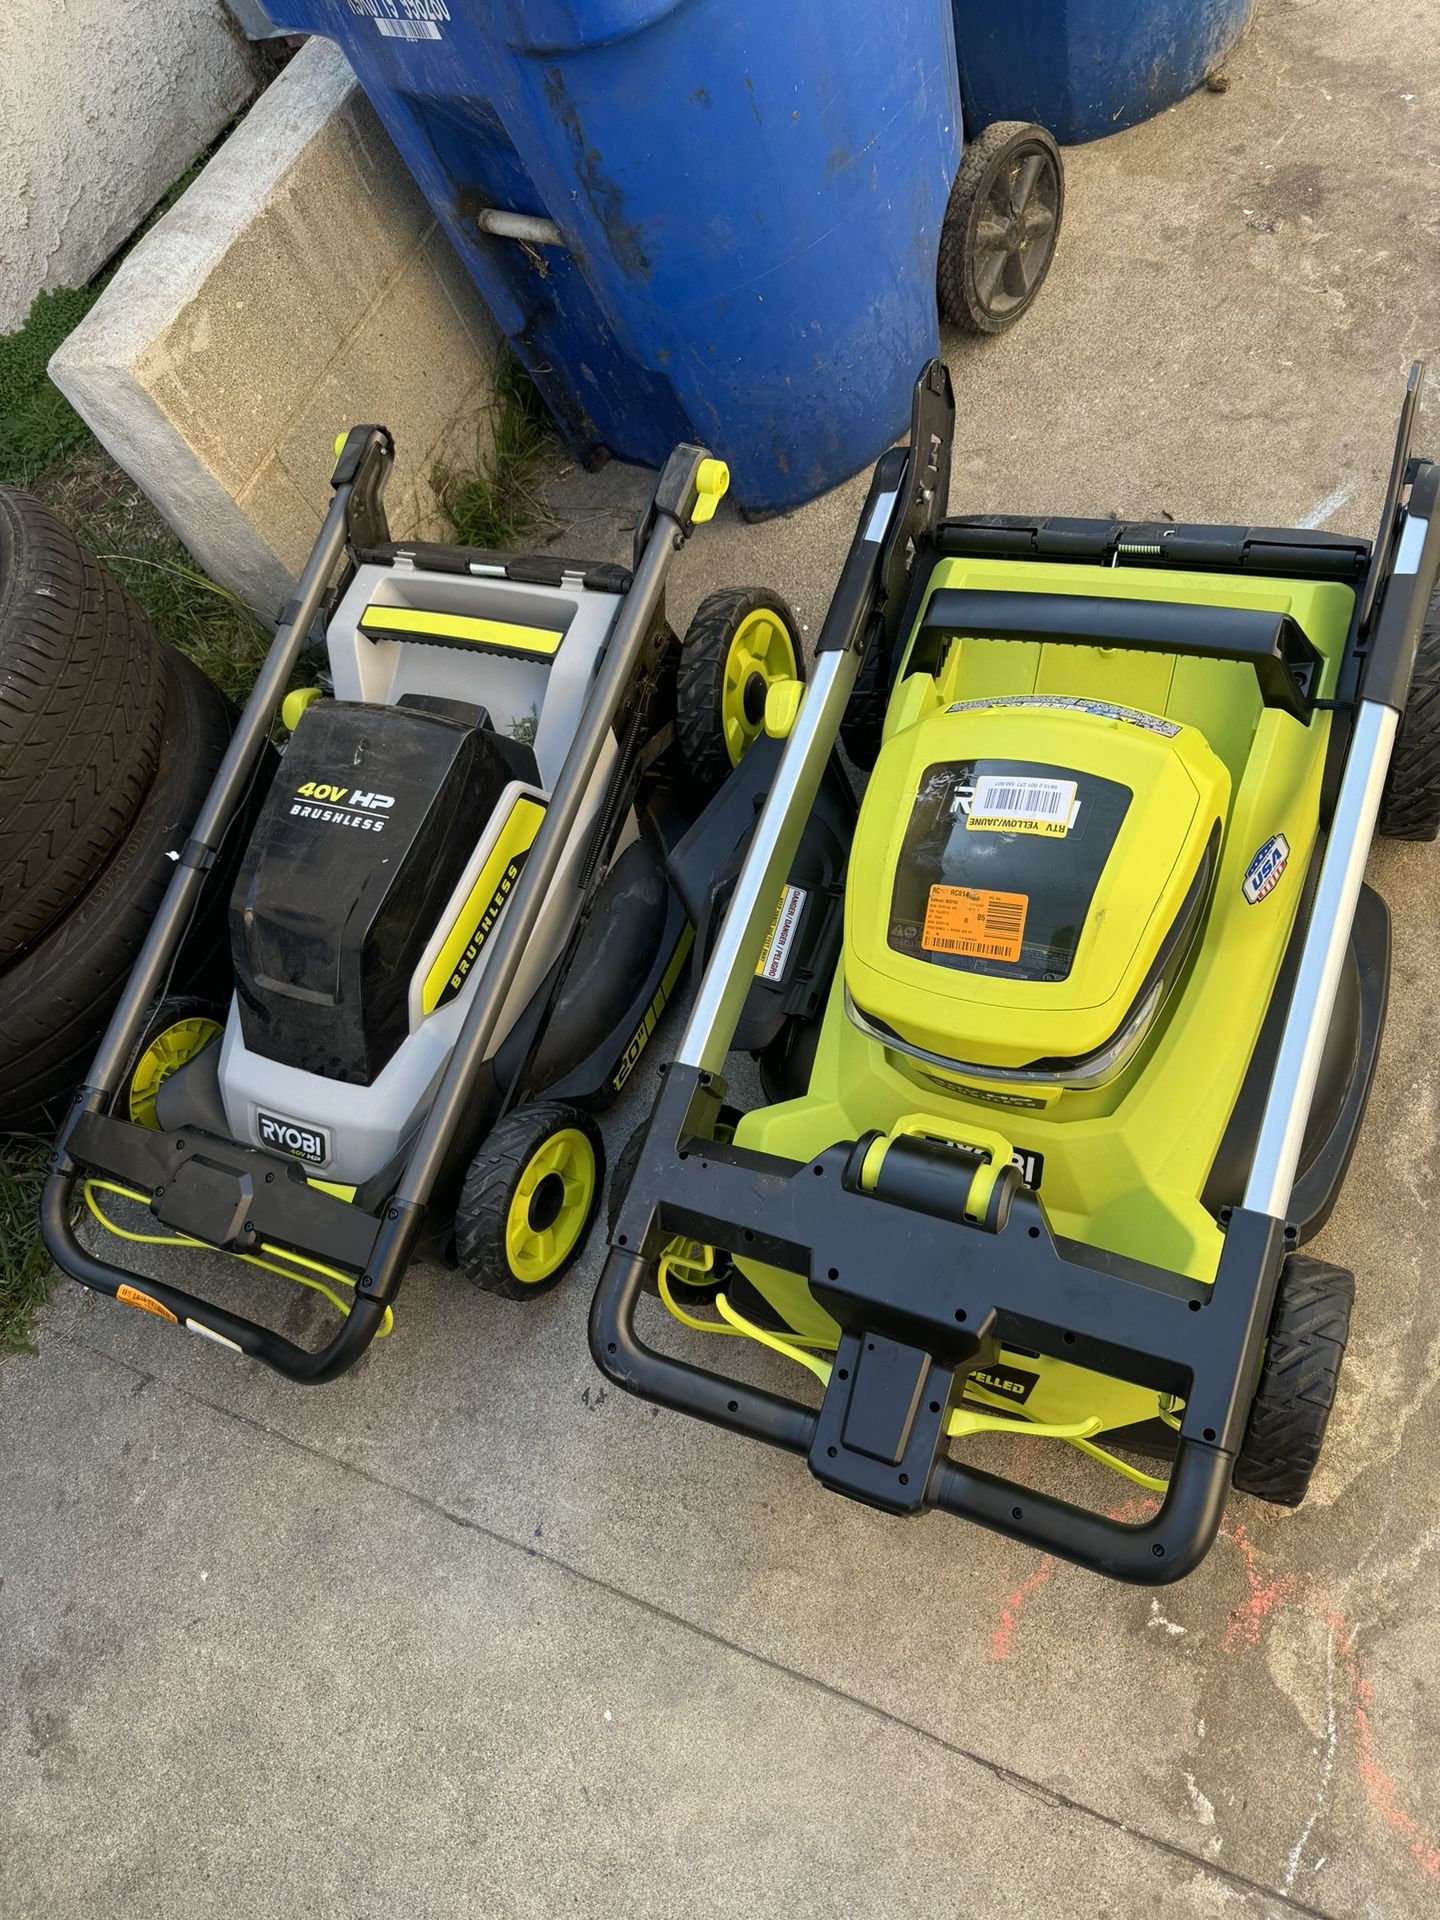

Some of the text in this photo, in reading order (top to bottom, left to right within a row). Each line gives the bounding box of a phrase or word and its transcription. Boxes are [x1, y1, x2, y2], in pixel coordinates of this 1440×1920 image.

[297, 781, 396, 809] 40V HP
[290, 804, 385, 832] BRUSHLESS
[969, 818, 1066, 833] RTV YELLOW/JAUNE
[1252, 848, 1282, 891] USA
[450, 864, 518, 989] BRUSHLESS
[261, 1118, 321, 1156] RYOBI
